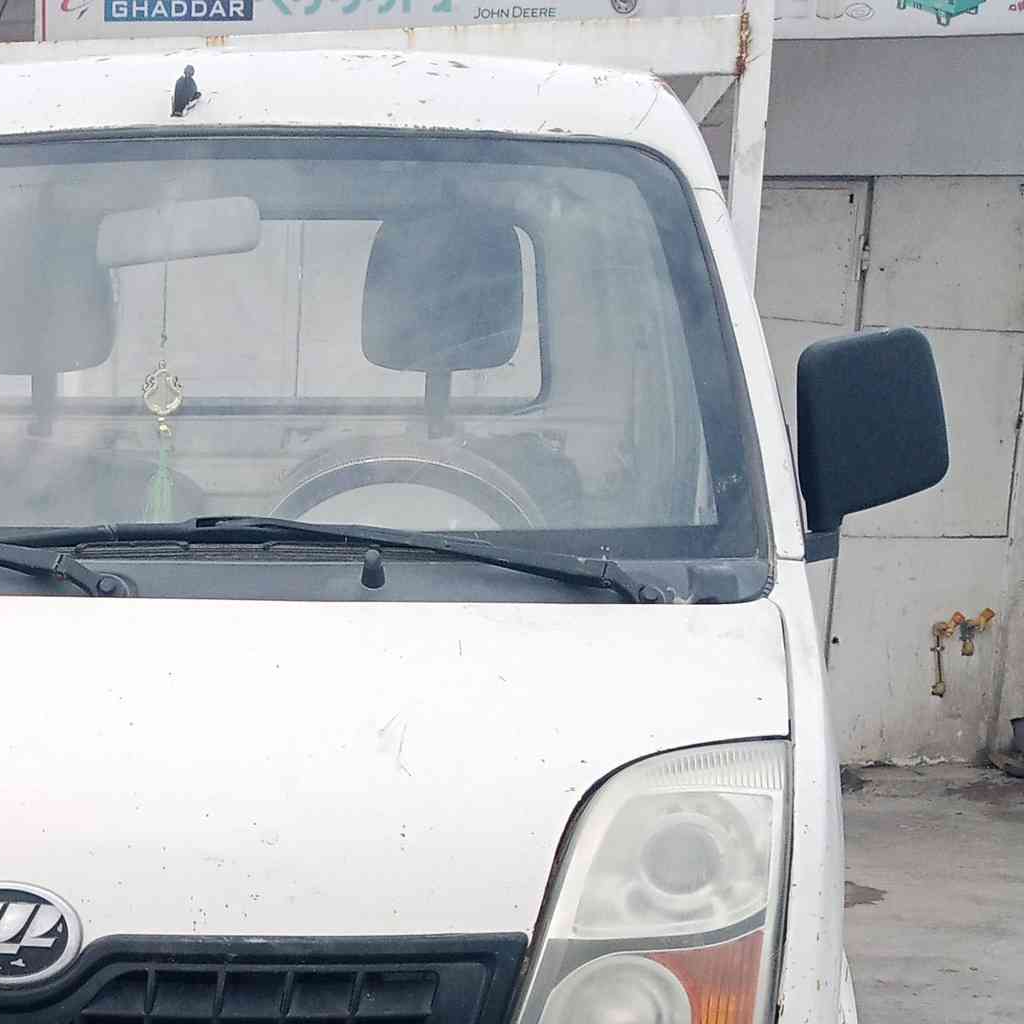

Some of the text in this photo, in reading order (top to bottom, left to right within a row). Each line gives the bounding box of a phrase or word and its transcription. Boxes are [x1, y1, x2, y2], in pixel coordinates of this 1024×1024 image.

[111, 0, 245, 18] GHADDAR
[473, 6, 557, 19] JOHN DEERE
